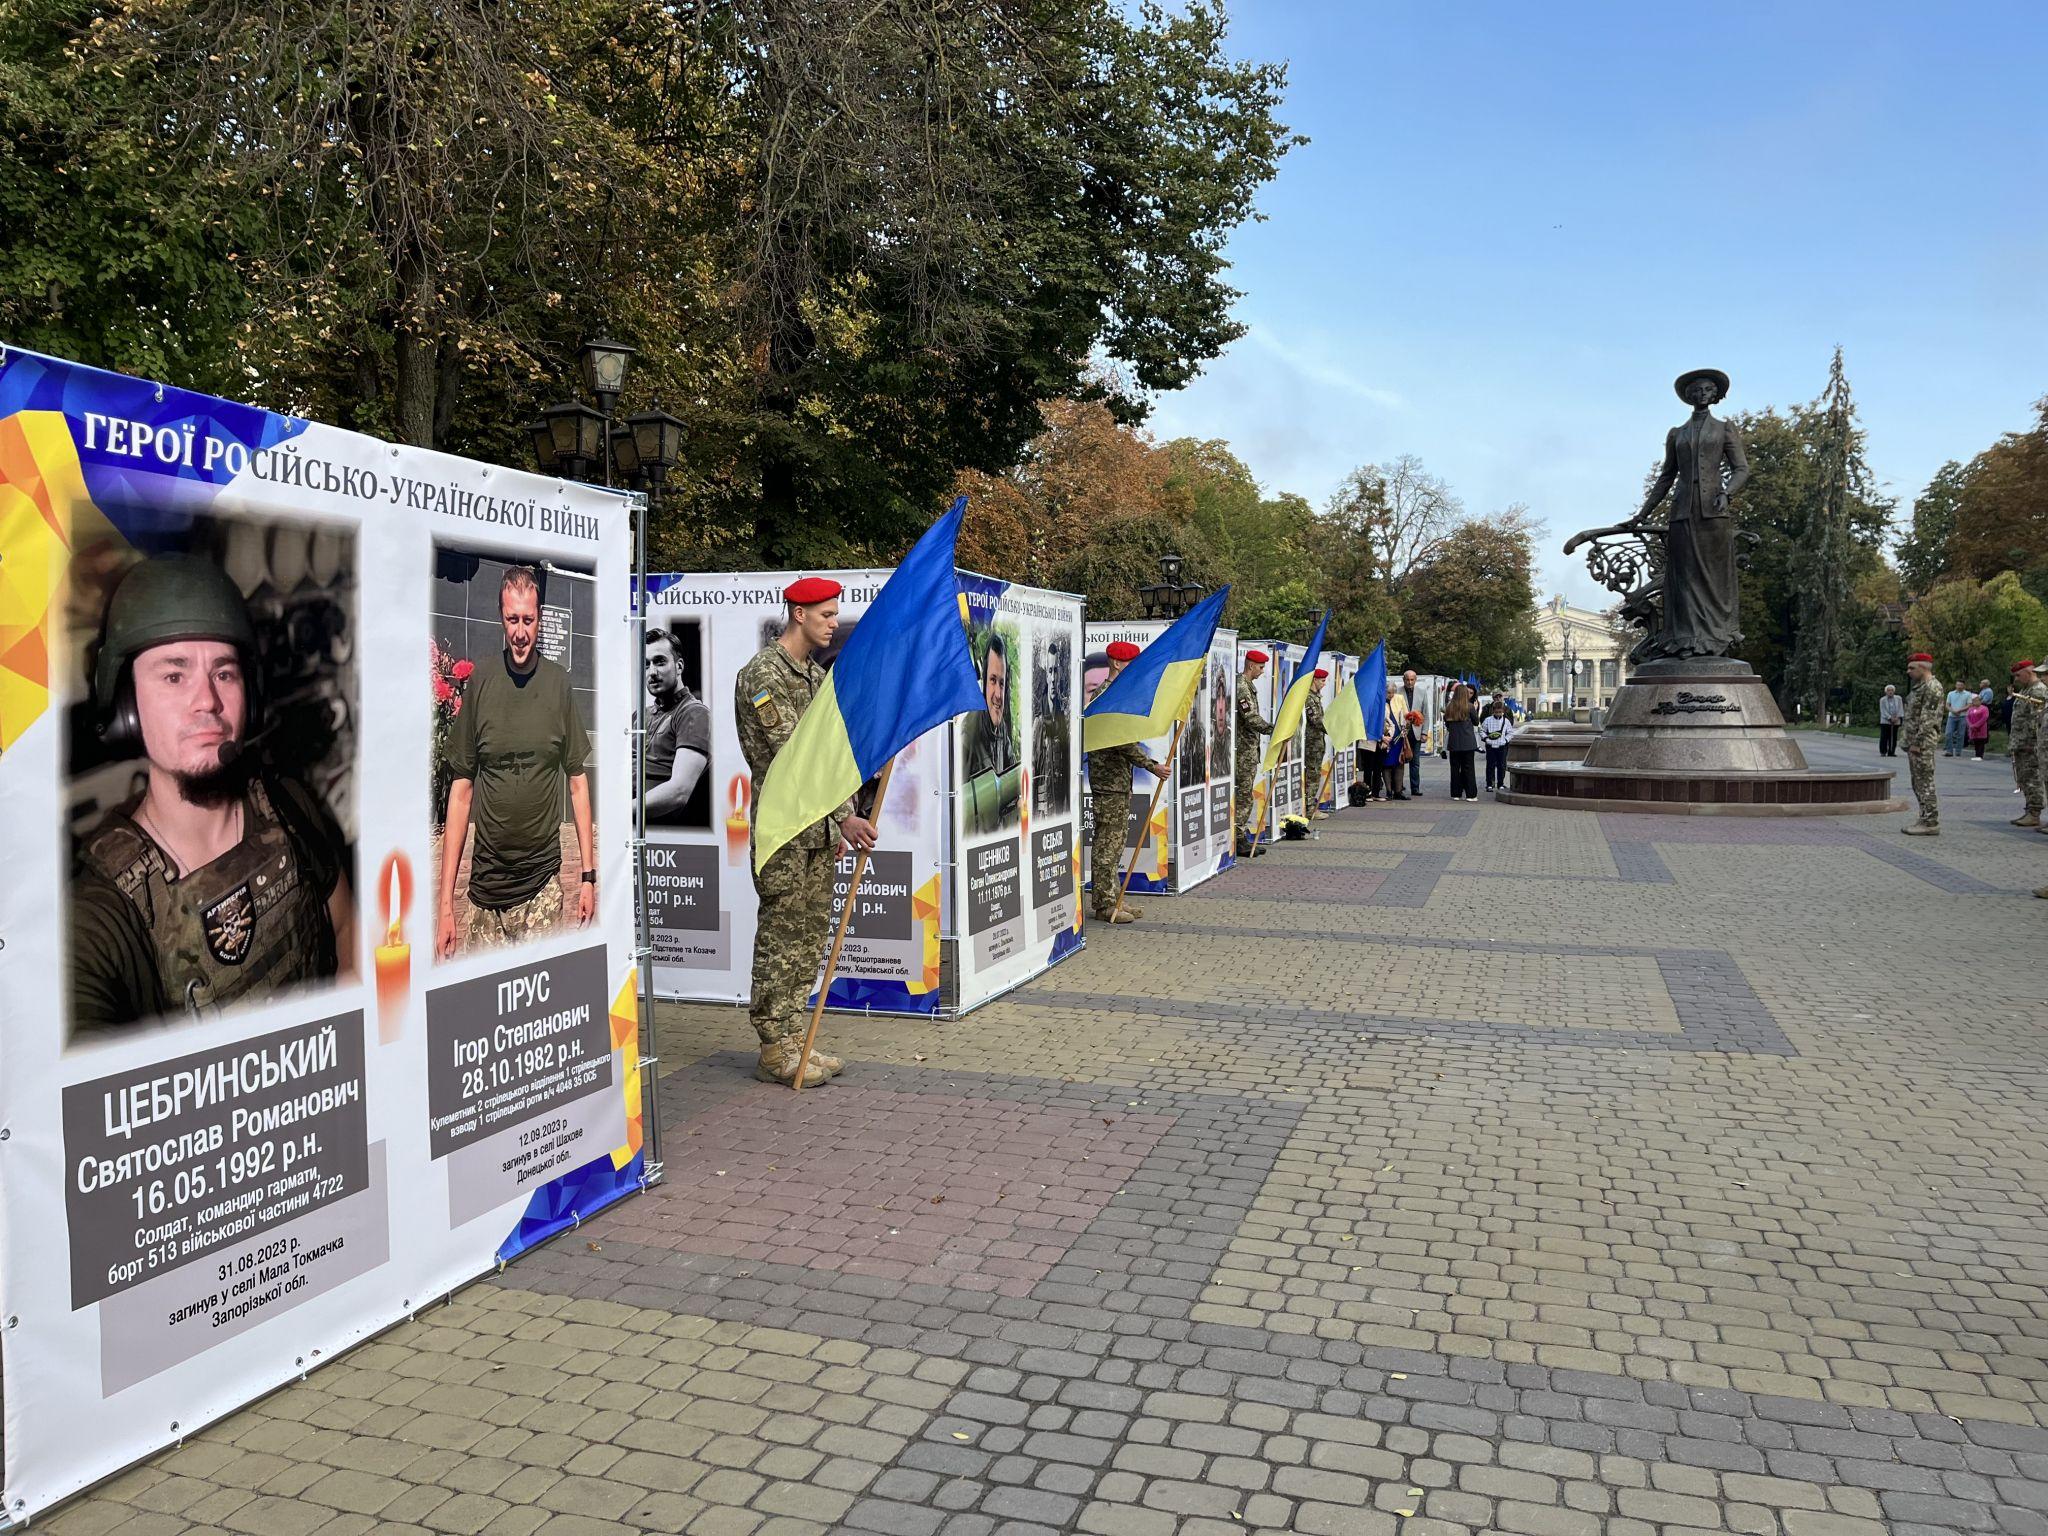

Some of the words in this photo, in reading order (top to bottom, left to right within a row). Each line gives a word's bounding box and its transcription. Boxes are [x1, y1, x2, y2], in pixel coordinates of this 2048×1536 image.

[83, 411, 196, 468] ГЕРОЇ
[202, 435, 536, 530] РОСІЙСЬКО-УКРАЇНСЬКОЇ
[540, 504, 601, 541] ВІЙНИ
[851, 583, 882, 603] ВІЙ
[967, 591, 989, 609] ГЕРОЇ
[1113, 632, 1150, 643] ВІЙНИ
[673, 894, 697, 908] р.н.
[862, 902, 887, 916] р.н.
[497, 970, 550, 1016] ПРУС
[854, 965, 894, 975] Харківської
[453, 1037, 489, 1068] Ігор
[494, 1004, 590, 1053] Степанович
[104, 1024, 338, 1140] ЦЕБРИНСЬКИЙ
[461, 1043, 554, 1099] 28.10.1982
[558, 1038, 585, 1069] р.н.
[430, 1105, 477, 1131] Кулеметник
[477, 1100, 483, 1112] 2
[484, 1085, 530, 1111] стрілецького
[531, 1074, 565, 1092] відділення
[450, 1119, 477, 1138] взводу
[485, 1097, 526, 1124] стрілецької
[526, 1093, 543, 1109] роти
[573, 1076, 583, 1088] 35
[77, 1123, 224, 1195] Святослав
[232, 1078, 360, 1143] Романович
[502, 1152, 532, 1173] загинув
[540, 1141, 555, 1156] селі
[556, 1127, 584, 1148] Шахове
[518, 1119, 561, 1147] 12.09.2023
[131, 1141, 276, 1220] 16.05.1992
[282, 1131, 323, 1173] р.н.
[516, 1155, 555, 1185] Донецької
[556, 1149, 572, 1165] обл.
[107, 1257, 145, 1286] борт
[148, 1240, 178, 1269] 513
[181, 1212, 256, 1256] військової
[258, 1193, 310, 1223] частини
[312, 1174, 344, 1201] 4722
[134, 1215, 194, 1249] Солдат,
[197, 1187, 264, 1230] командир
[267, 1166, 322, 1202] гармати,
[168, 1296, 218, 1326] загинув
[221, 1289, 229, 1303] у
[231, 1277, 256, 1297] селі
[259, 1263, 290, 1288] Мала
[292, 1236, 345, 1270] Токмачка
[218, 1239, 287, 1282] 31.08.2023
[289, 1237, 301, 1254] р.
[211, 1284, 282, 1328] Запорізької
[284, 1274, 309, 1296] обл.
